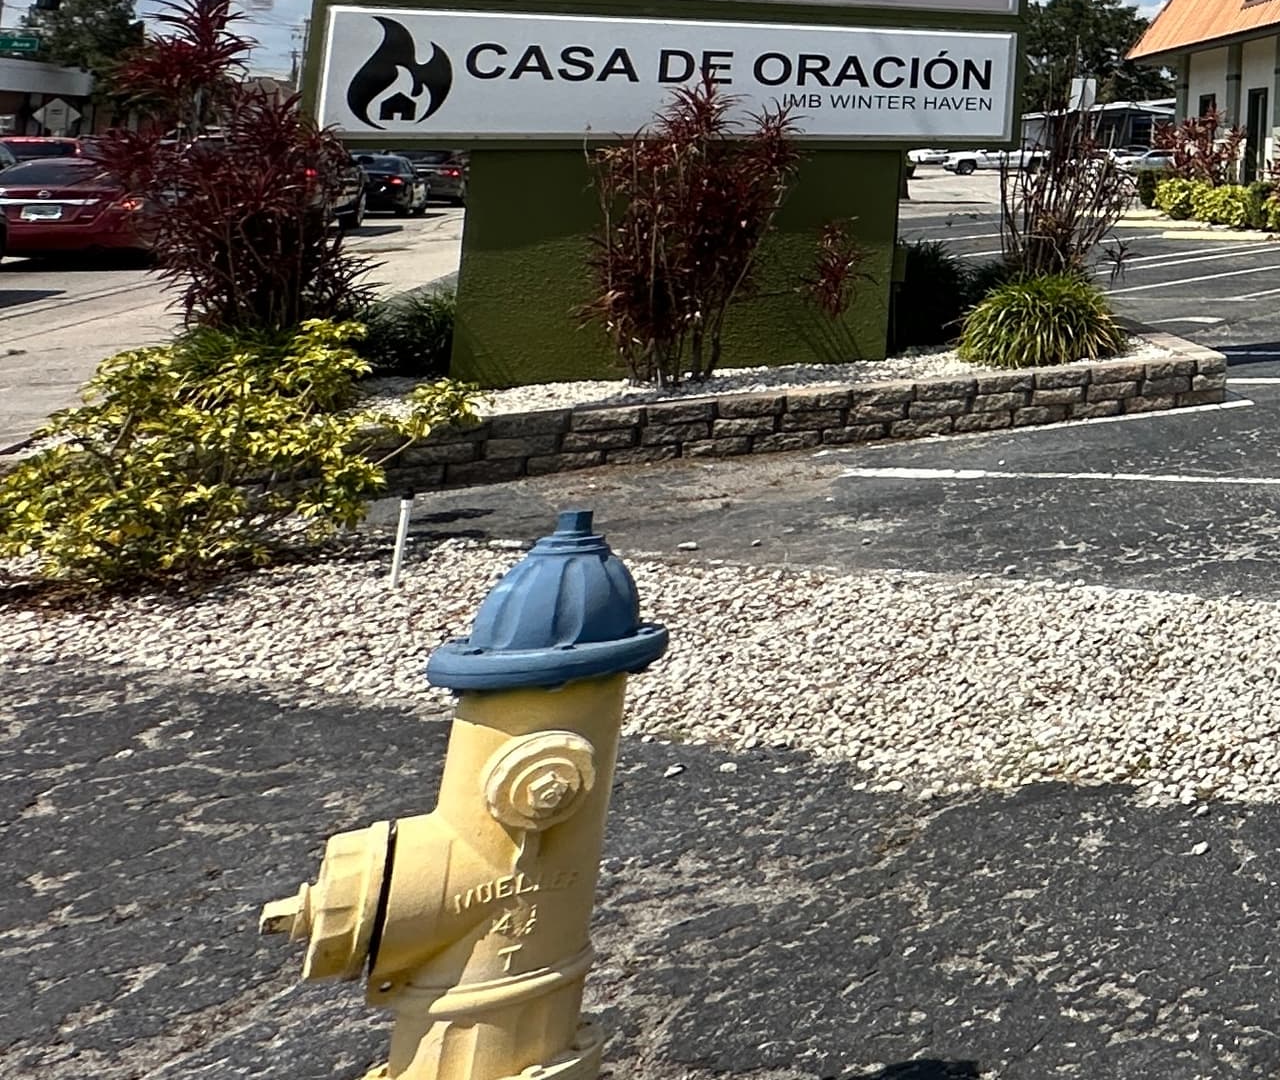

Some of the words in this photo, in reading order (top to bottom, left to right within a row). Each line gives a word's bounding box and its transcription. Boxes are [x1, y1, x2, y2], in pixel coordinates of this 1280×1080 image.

[465, 43, 640, 83] CASA
[657, 49, 735, 85] DE
[753, 51, 993, 91] ORACIÓN
[782, 93, 822, 109] IMB
[830, 94, 917, 111] WINTER
[923, 96, 993, 112] HAVEN
